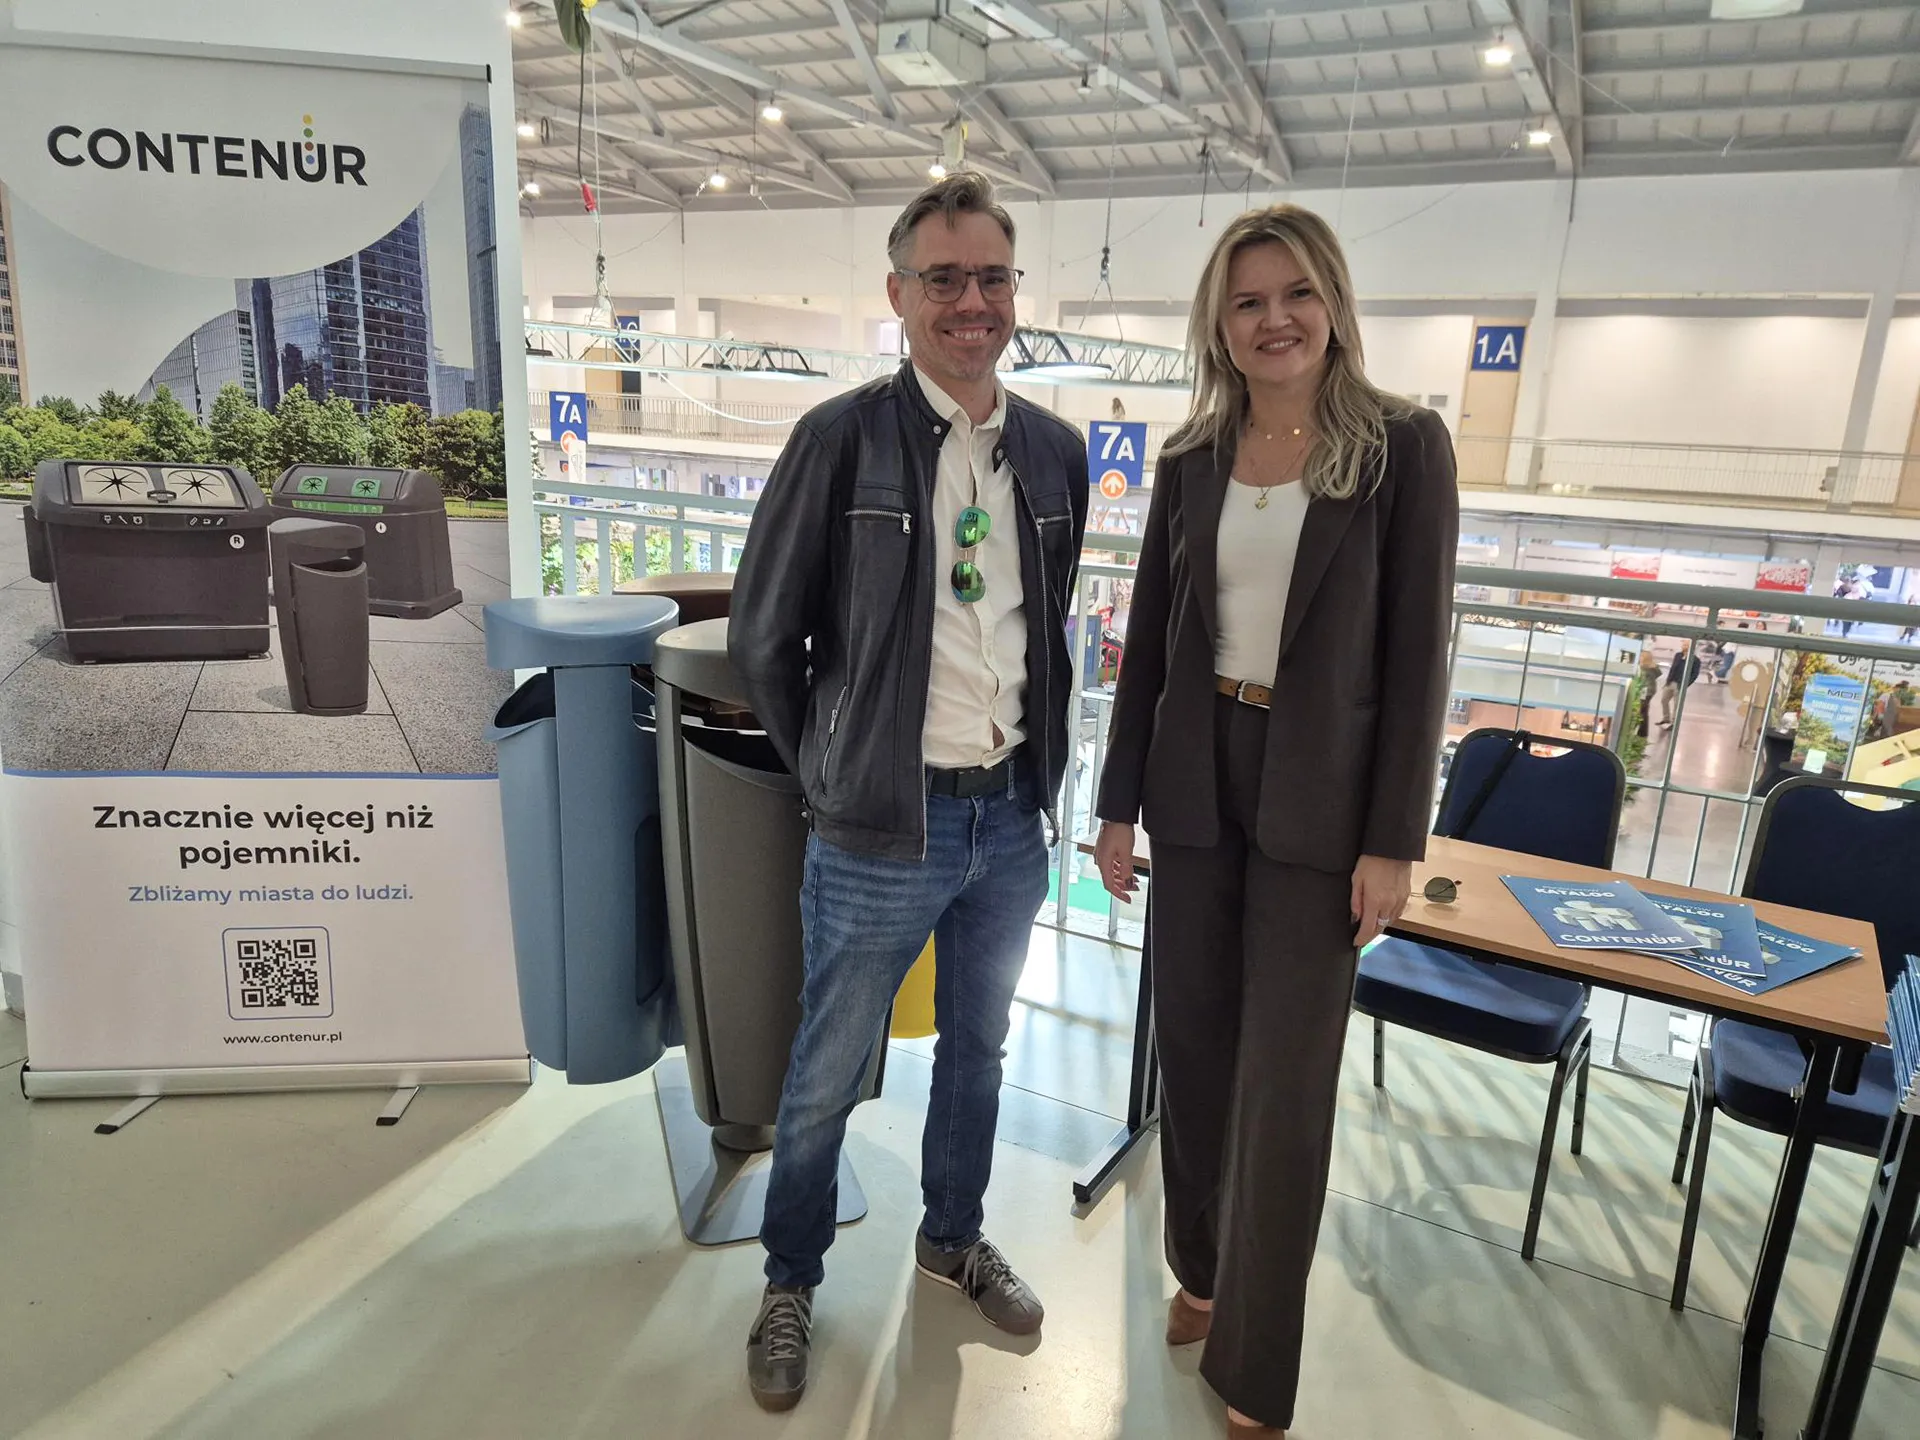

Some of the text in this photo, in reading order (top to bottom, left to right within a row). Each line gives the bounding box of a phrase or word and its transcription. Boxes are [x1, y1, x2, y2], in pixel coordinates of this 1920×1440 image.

[47, 124, 368, 187] CONTENUR
[1476, 332, 1517, 364] 1.A
[555, 395, 582, 424] 7A
[1098, 424, 1136, 462] 7A
[93, 804, 434, 834] Znacznie więcej niż
[179, 839, 361, 869] pojemniki.
[128, 883, 414, 905] Zbliżamy miasta do ludzi.
[1560, 933, 1685, 945] CONTENUR
[223, 1031, 342, 1044] www.contenur.pl
